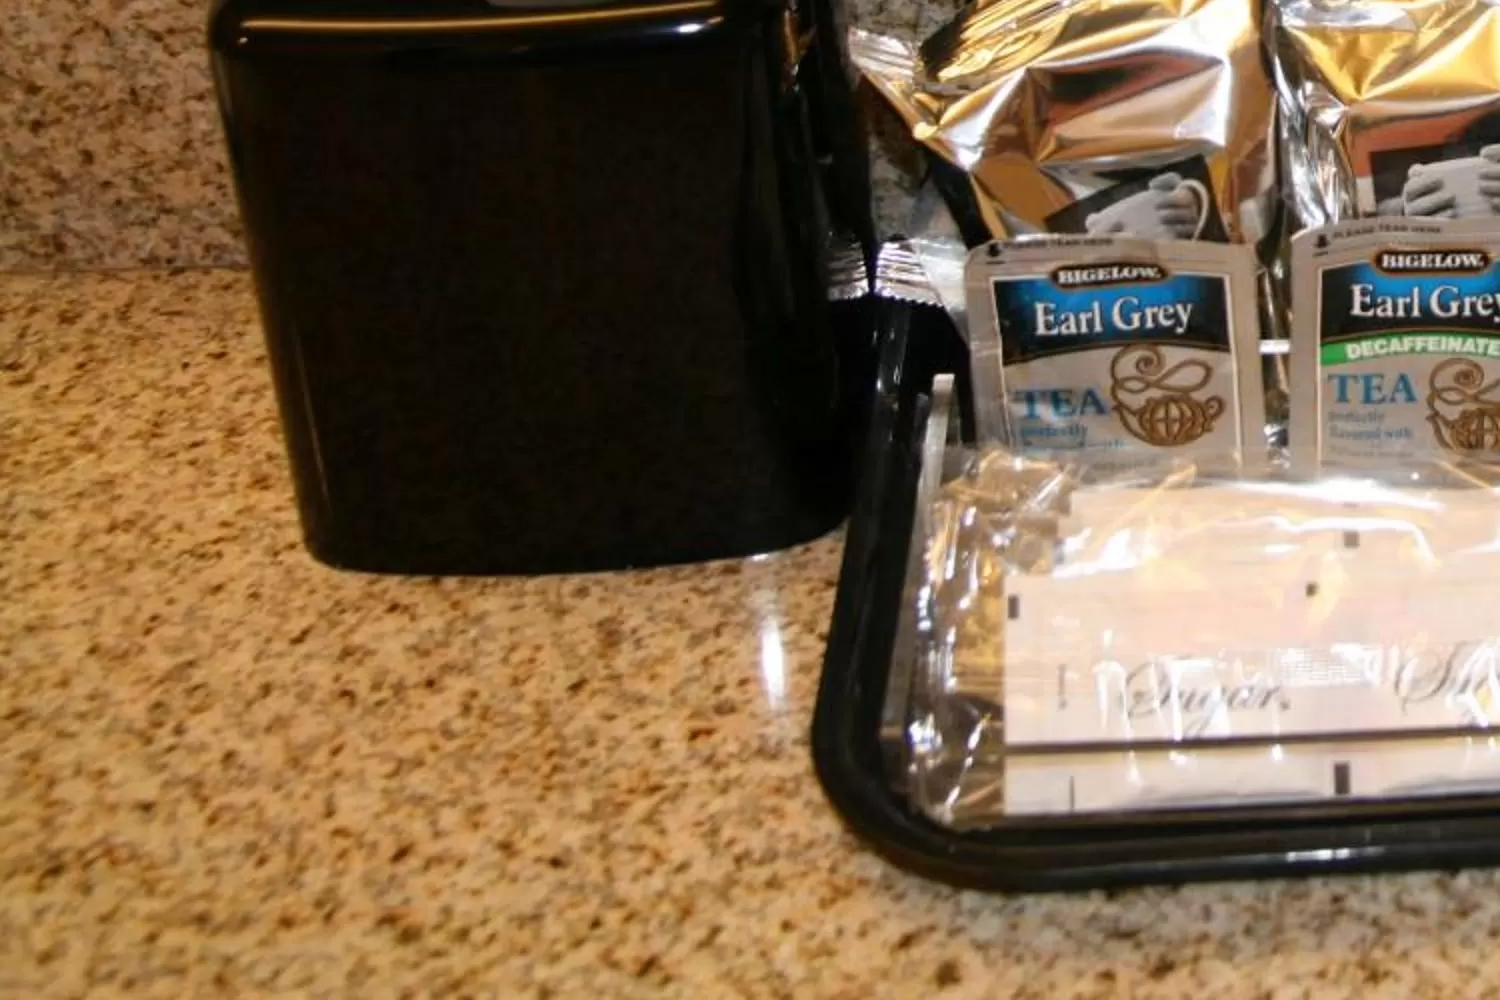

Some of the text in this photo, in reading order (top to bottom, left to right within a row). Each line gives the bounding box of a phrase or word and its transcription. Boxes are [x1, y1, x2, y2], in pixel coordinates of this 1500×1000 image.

[1057, 265, 1160, 286] BIGELOW
[1381, 252, 1483, 270] BIGELOW
[1034, 296, 1193, 336] Earl Grey
[1350, 283, 1421, 318] Earl
[1014, 387, 1108, 420] TEA
[1327, 372, 1417, 405] TEA
